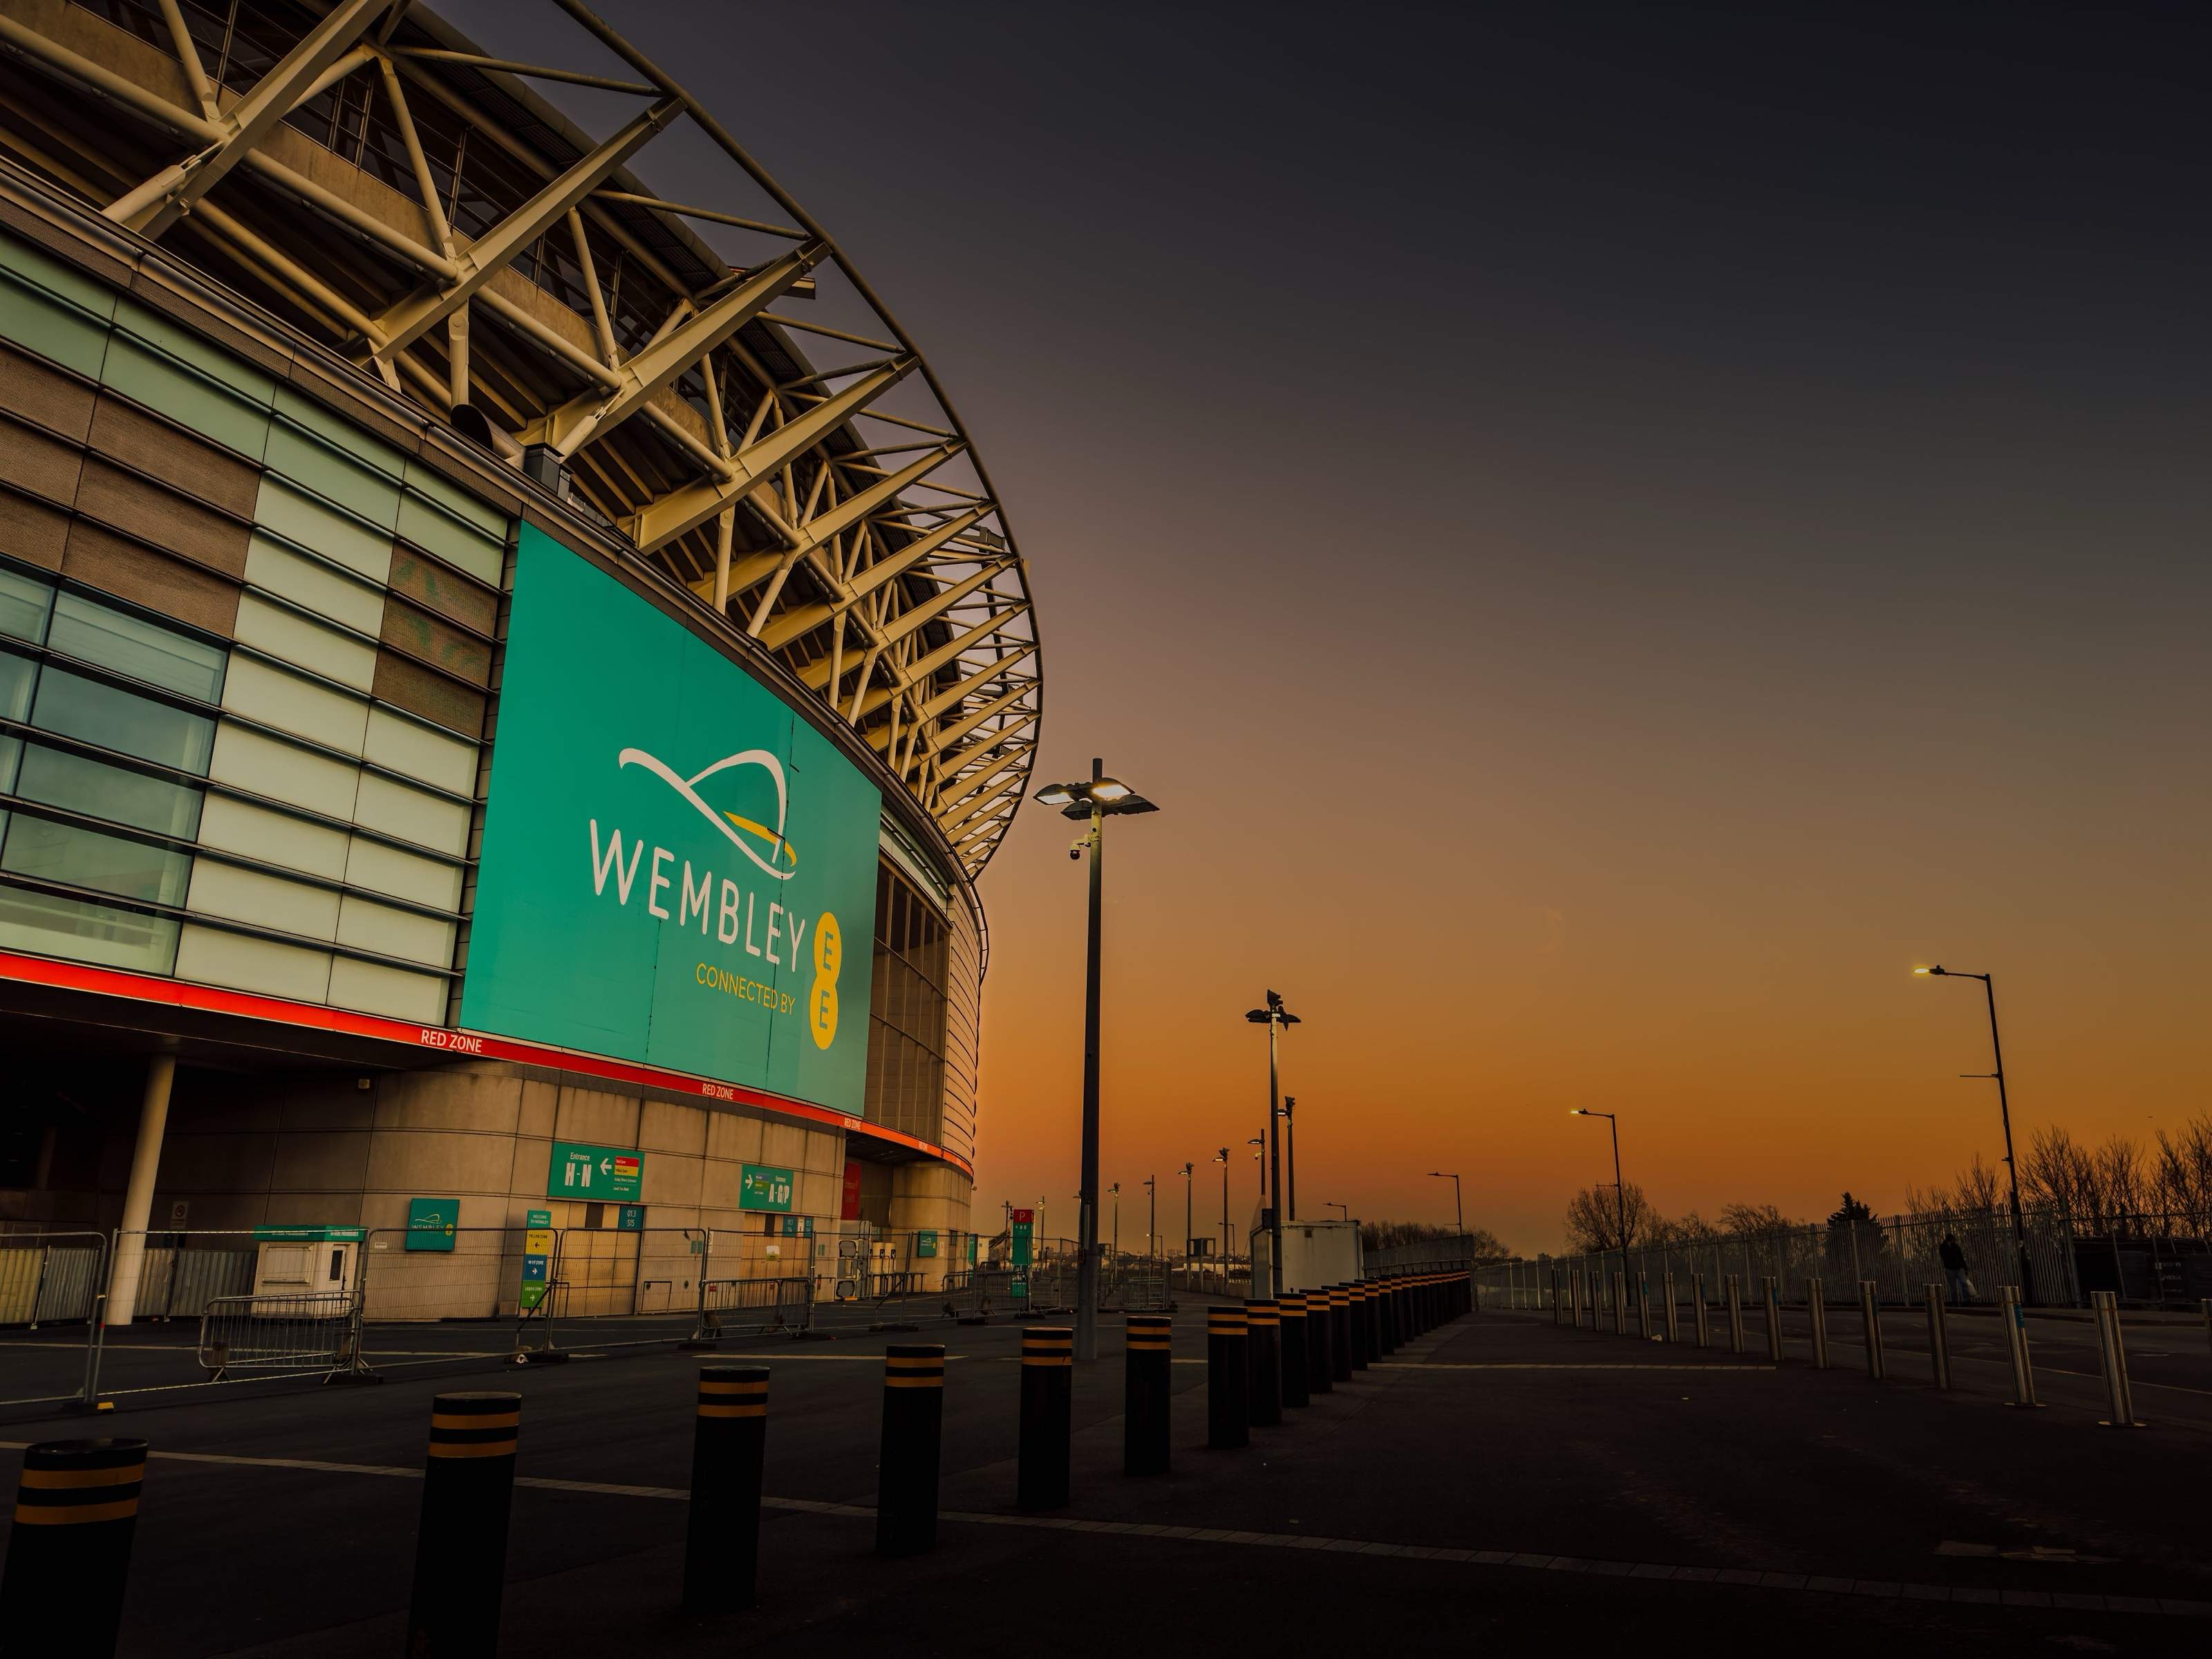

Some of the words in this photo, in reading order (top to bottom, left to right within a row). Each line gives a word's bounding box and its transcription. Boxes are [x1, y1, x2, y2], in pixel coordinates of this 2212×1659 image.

[590, 818, 805, 973] WEMBLEY
[696, 962, 778, 1009] CONNECTED
[780, 993, 795, 1015] BY
[421, 1029, 447, 1047] RED
[449, 1034, 482, 1053] ZONE
[702, 1083, 715, 1096] RED
[716, 1086, 733, 1100] ZONE
[570, 1152, 590, 1161] Entrance
[1020, 1211, 1026, 1222] P
